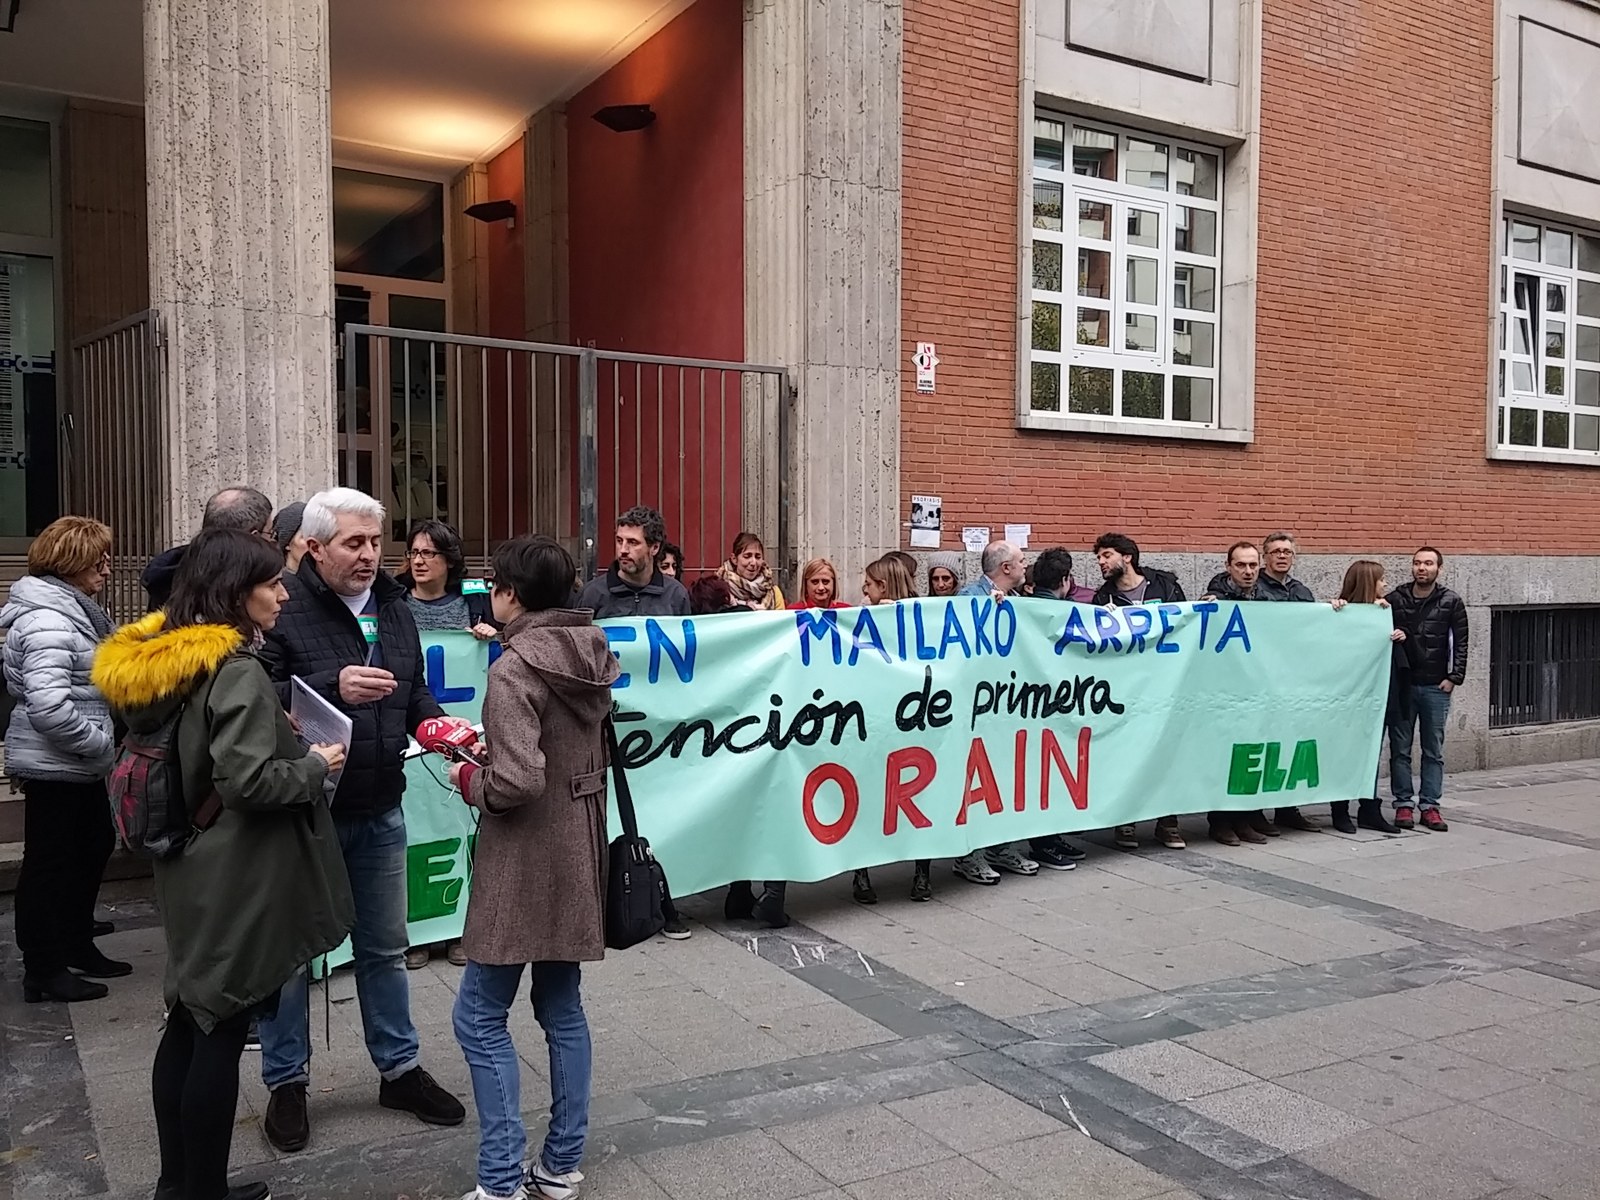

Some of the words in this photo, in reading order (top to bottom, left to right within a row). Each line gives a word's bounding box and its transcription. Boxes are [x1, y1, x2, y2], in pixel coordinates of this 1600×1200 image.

[795, 597, 1016, 666] MAILAKO
[1054, 602, 1251, 656] ARRETA
[895, 665, 953, 731] de
[972, 671, 1125, 731] primera
[803, 727, 1092, 845] ORAIN
[1227, 739, 1320, 795] ELA
